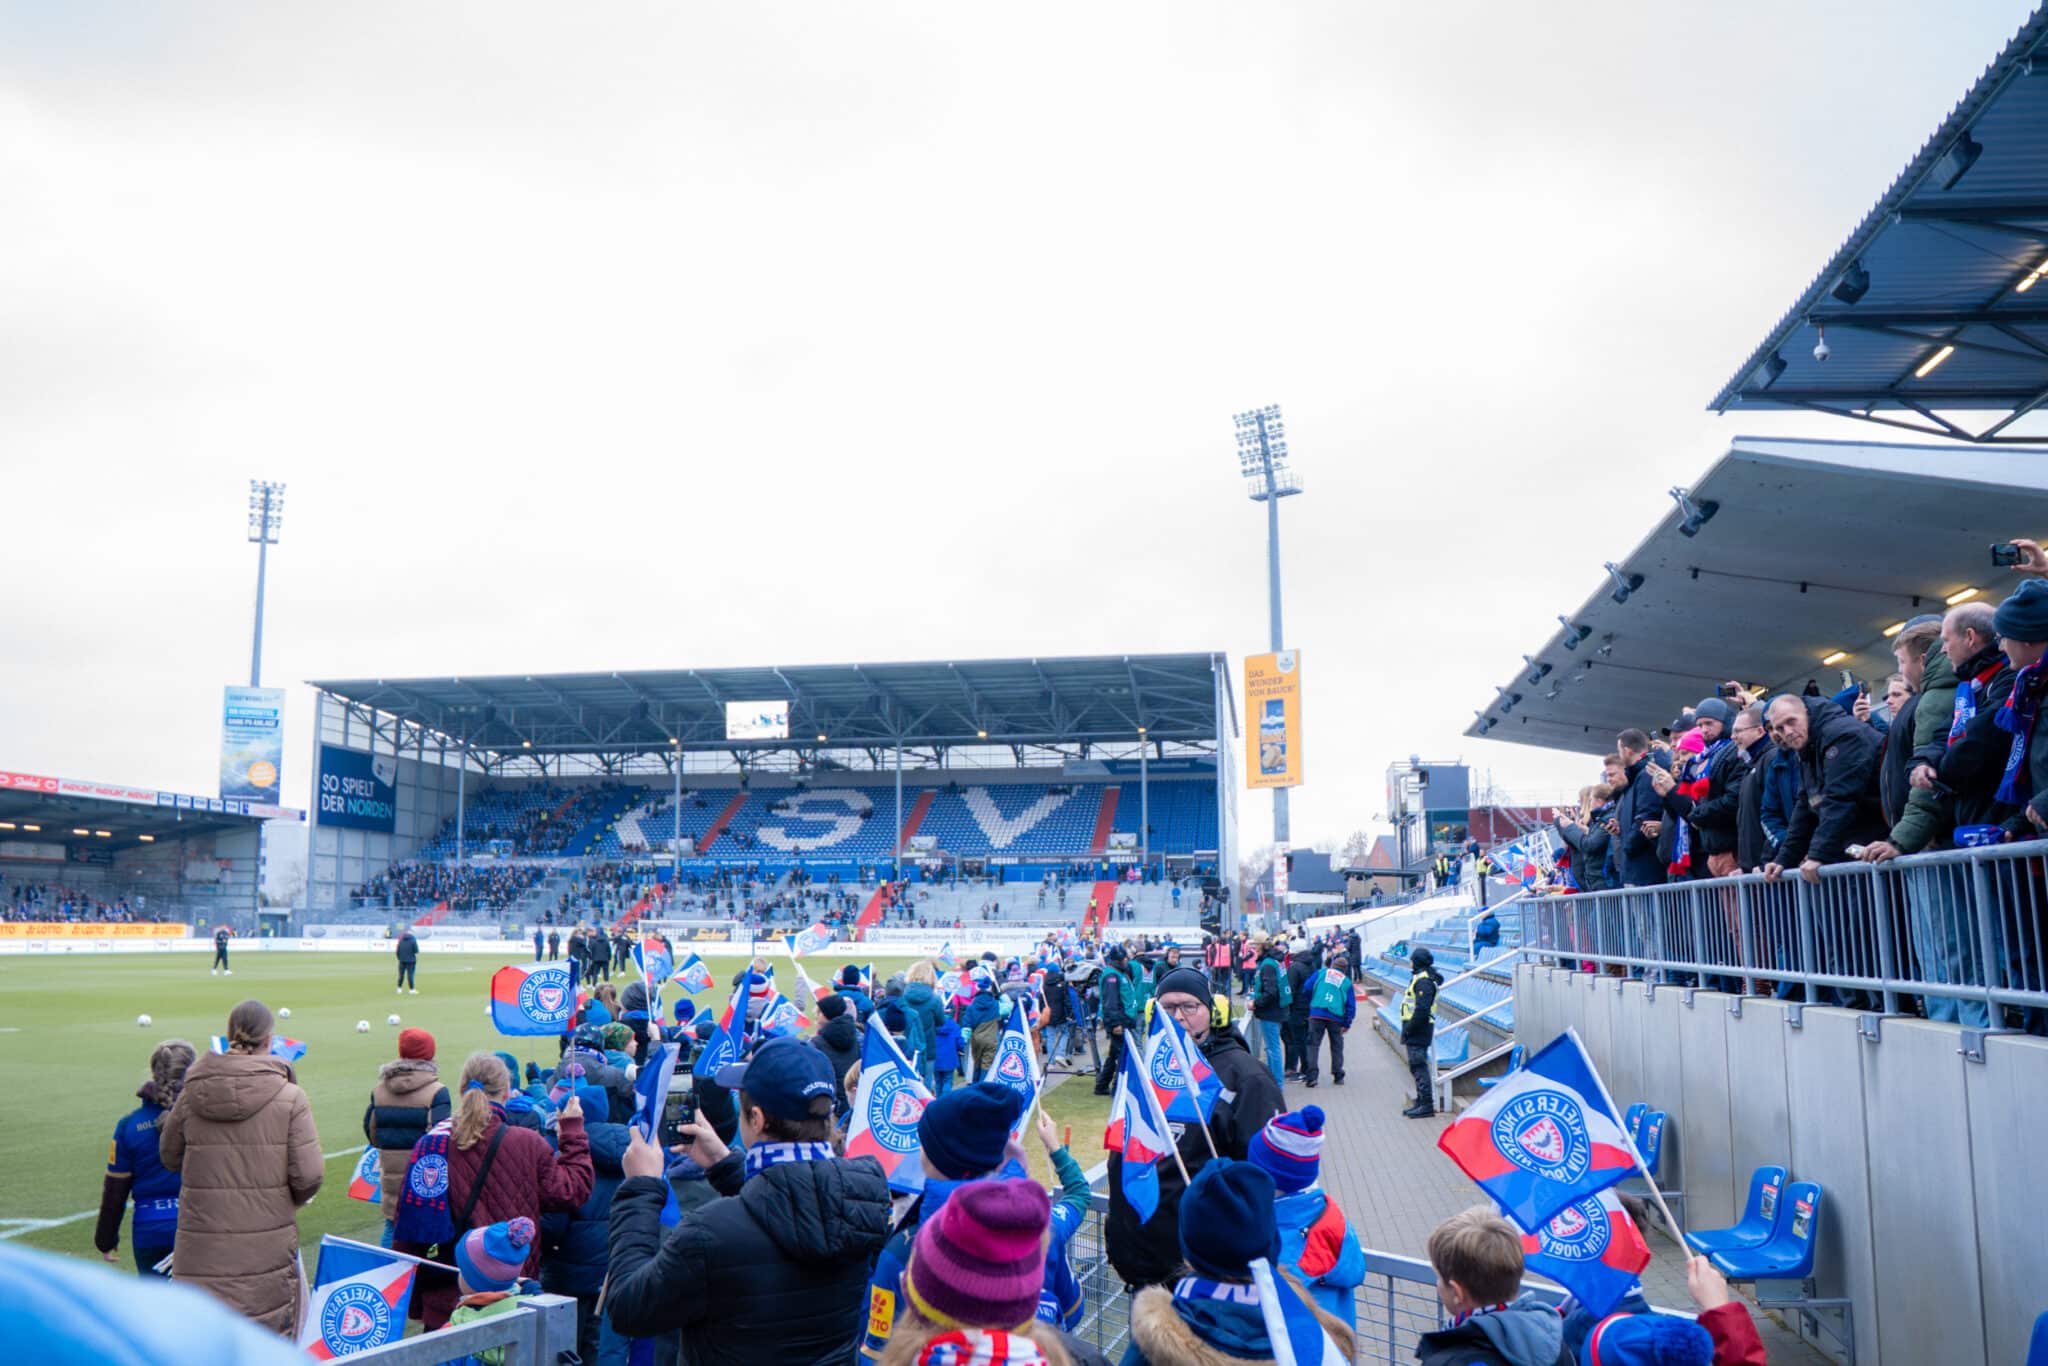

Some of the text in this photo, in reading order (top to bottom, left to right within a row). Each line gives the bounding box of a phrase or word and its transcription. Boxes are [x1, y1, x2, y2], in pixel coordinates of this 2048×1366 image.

[321, 774, 375, 797] SO SPIELT
[321, 793, 344, 813] DER
[347, 797, 392, 819] NORDEN
[960, 785, 1083, 848] V
[765, 857, 800, 866] EuroEyes
[37, 925, 63, 934] LOTTO
[122, 925, 144, 934] LOTTO
[162, 925, 183, 934] LOTTO
[1548, 1240, 1581, 1258] 1900
[1581, 1200, 1606, 1255] HOLSTEIN
